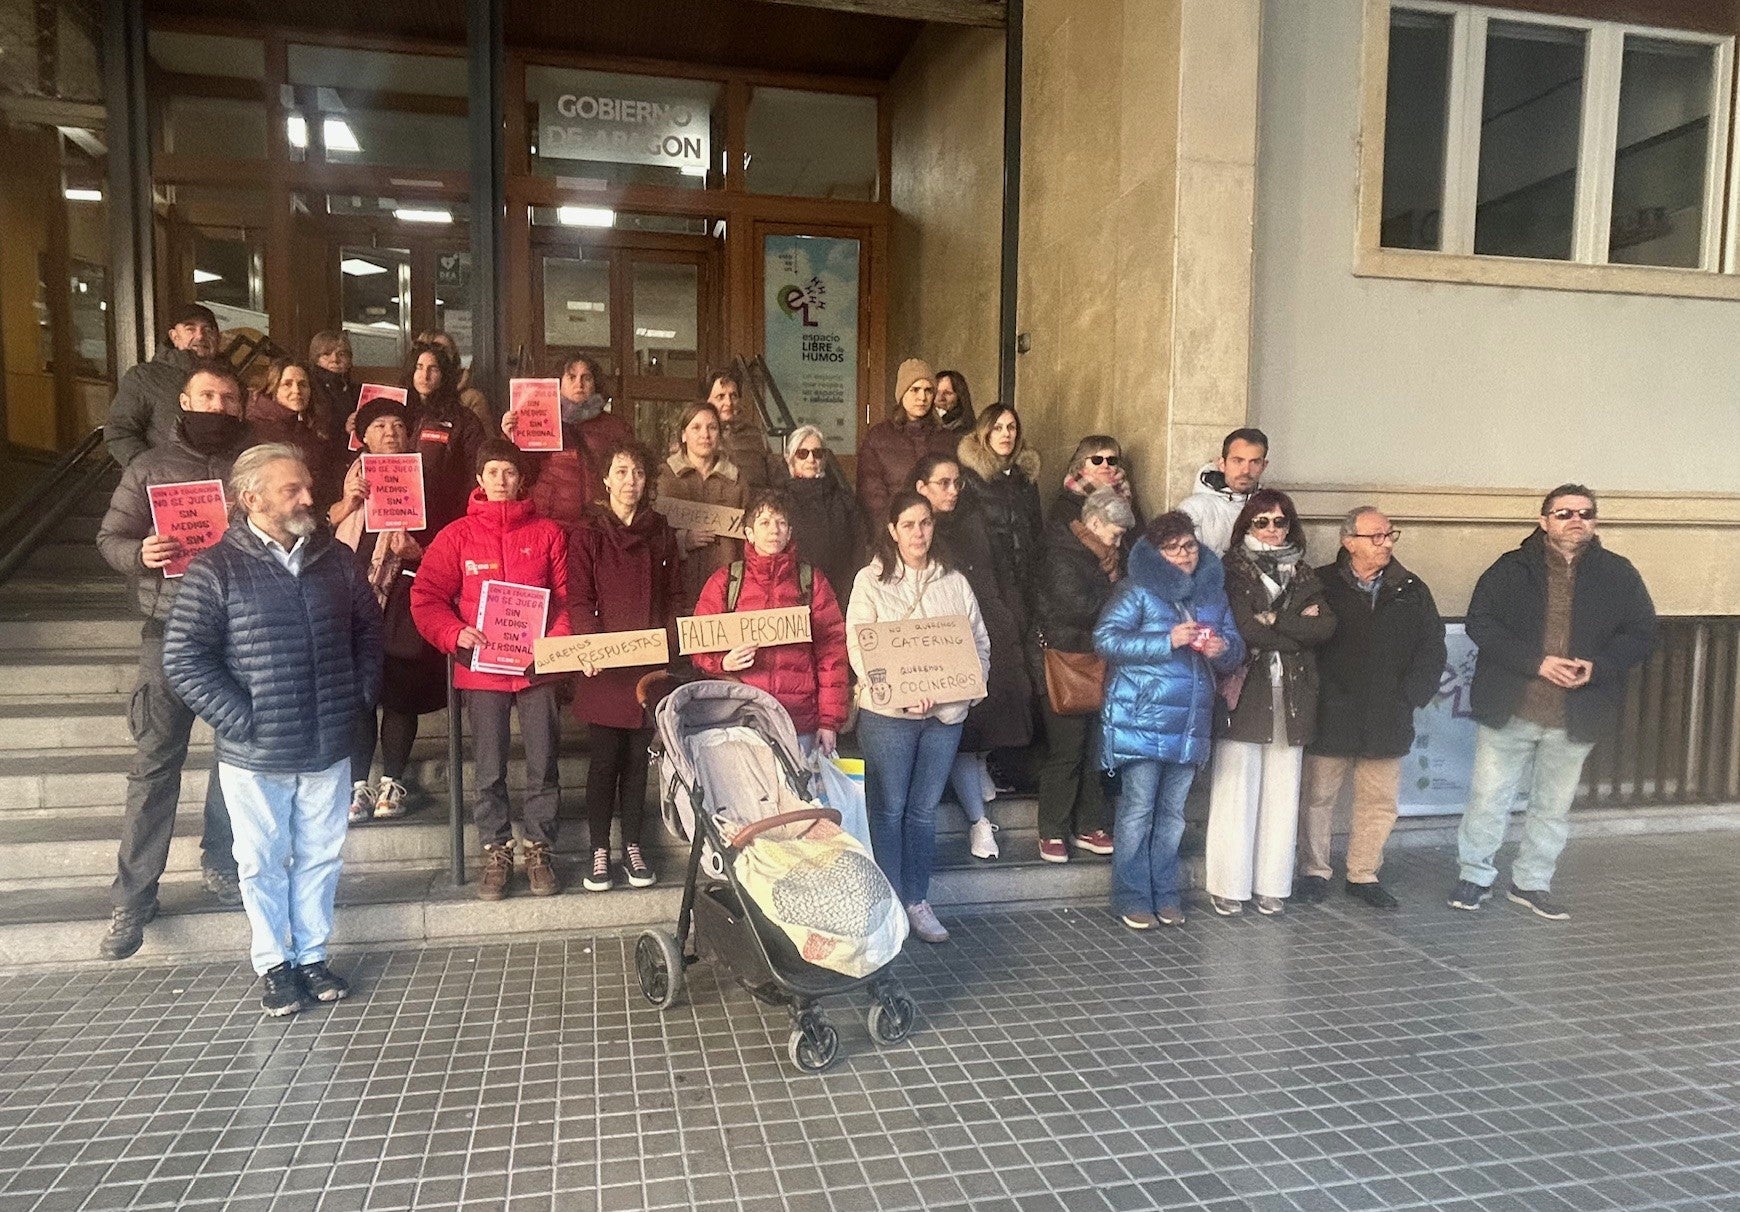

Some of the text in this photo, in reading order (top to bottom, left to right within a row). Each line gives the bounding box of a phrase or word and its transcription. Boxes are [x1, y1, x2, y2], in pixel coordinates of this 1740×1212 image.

[557, 94, 692, 127] GOBIERNO
[802, 333, 841, 343] espacio
[802, 342, 833, 352] LIBRE
[802, 353, 845, 363] HUMOS
[384, 475, 399, 483] SIN
[376, 485, 408, 493] MEDIOS
[154, 494, 221, 508] NO SE JUEGA
[387, 497, 403, 505] SIN
[179, 509, 198, 519] SIN
[372, 507, 418, 516] PERSONAL
[171, 520, 210, 531] MEDIOS
[186, 535, 205, 545] SIN
[487, 594, 545, 610] NO SE JUEGA
[505, 608, 521, 618] SIN
[494, 618, 529, 629] MEDIOS
[889, 621, 957, 634] NO QUEREMOS
[503, 632, 520, 641] SIN
[680, 613, 811, 650] FALTA PERSONAL
[891, 635, 964, 648] CATERING
[485, 641, 534, 655] PERSONAL
[537, 639, 592, 668] QUEREMOS
[577, 633, 663, 667] RESPUESTAS
[900, 664, 945, 676] QUEREMOS
[900, 673, 977, 695] COCINER@S
